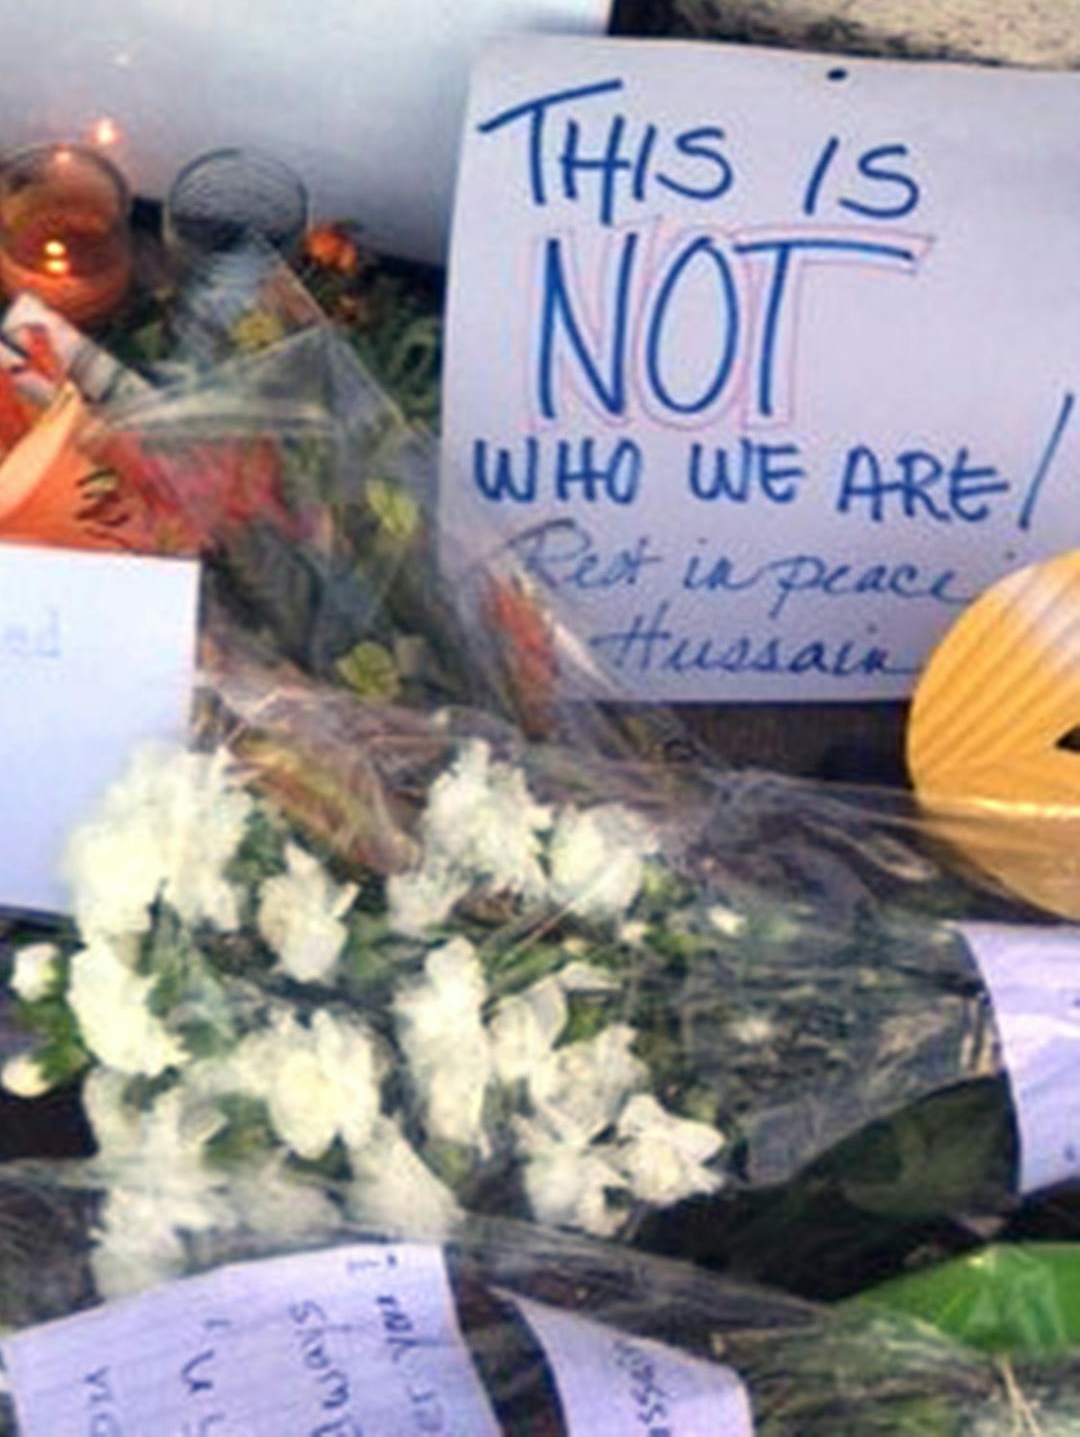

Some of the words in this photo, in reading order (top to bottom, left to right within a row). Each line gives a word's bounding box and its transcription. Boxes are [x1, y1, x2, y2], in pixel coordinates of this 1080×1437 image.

[478, 78, 734, 225] THIS
[803, 136, 920, 219] IS
[532, 223, 925, 425] NOT
[473, 438, 642, 505] WHO
[688, 442, 804, 503] WE
[506, 518, 662, 590] Rest
[682, 537, 754, 591] in
[750, 554, 980, 621] peace
[591, 602, 920, 676] Hussain
